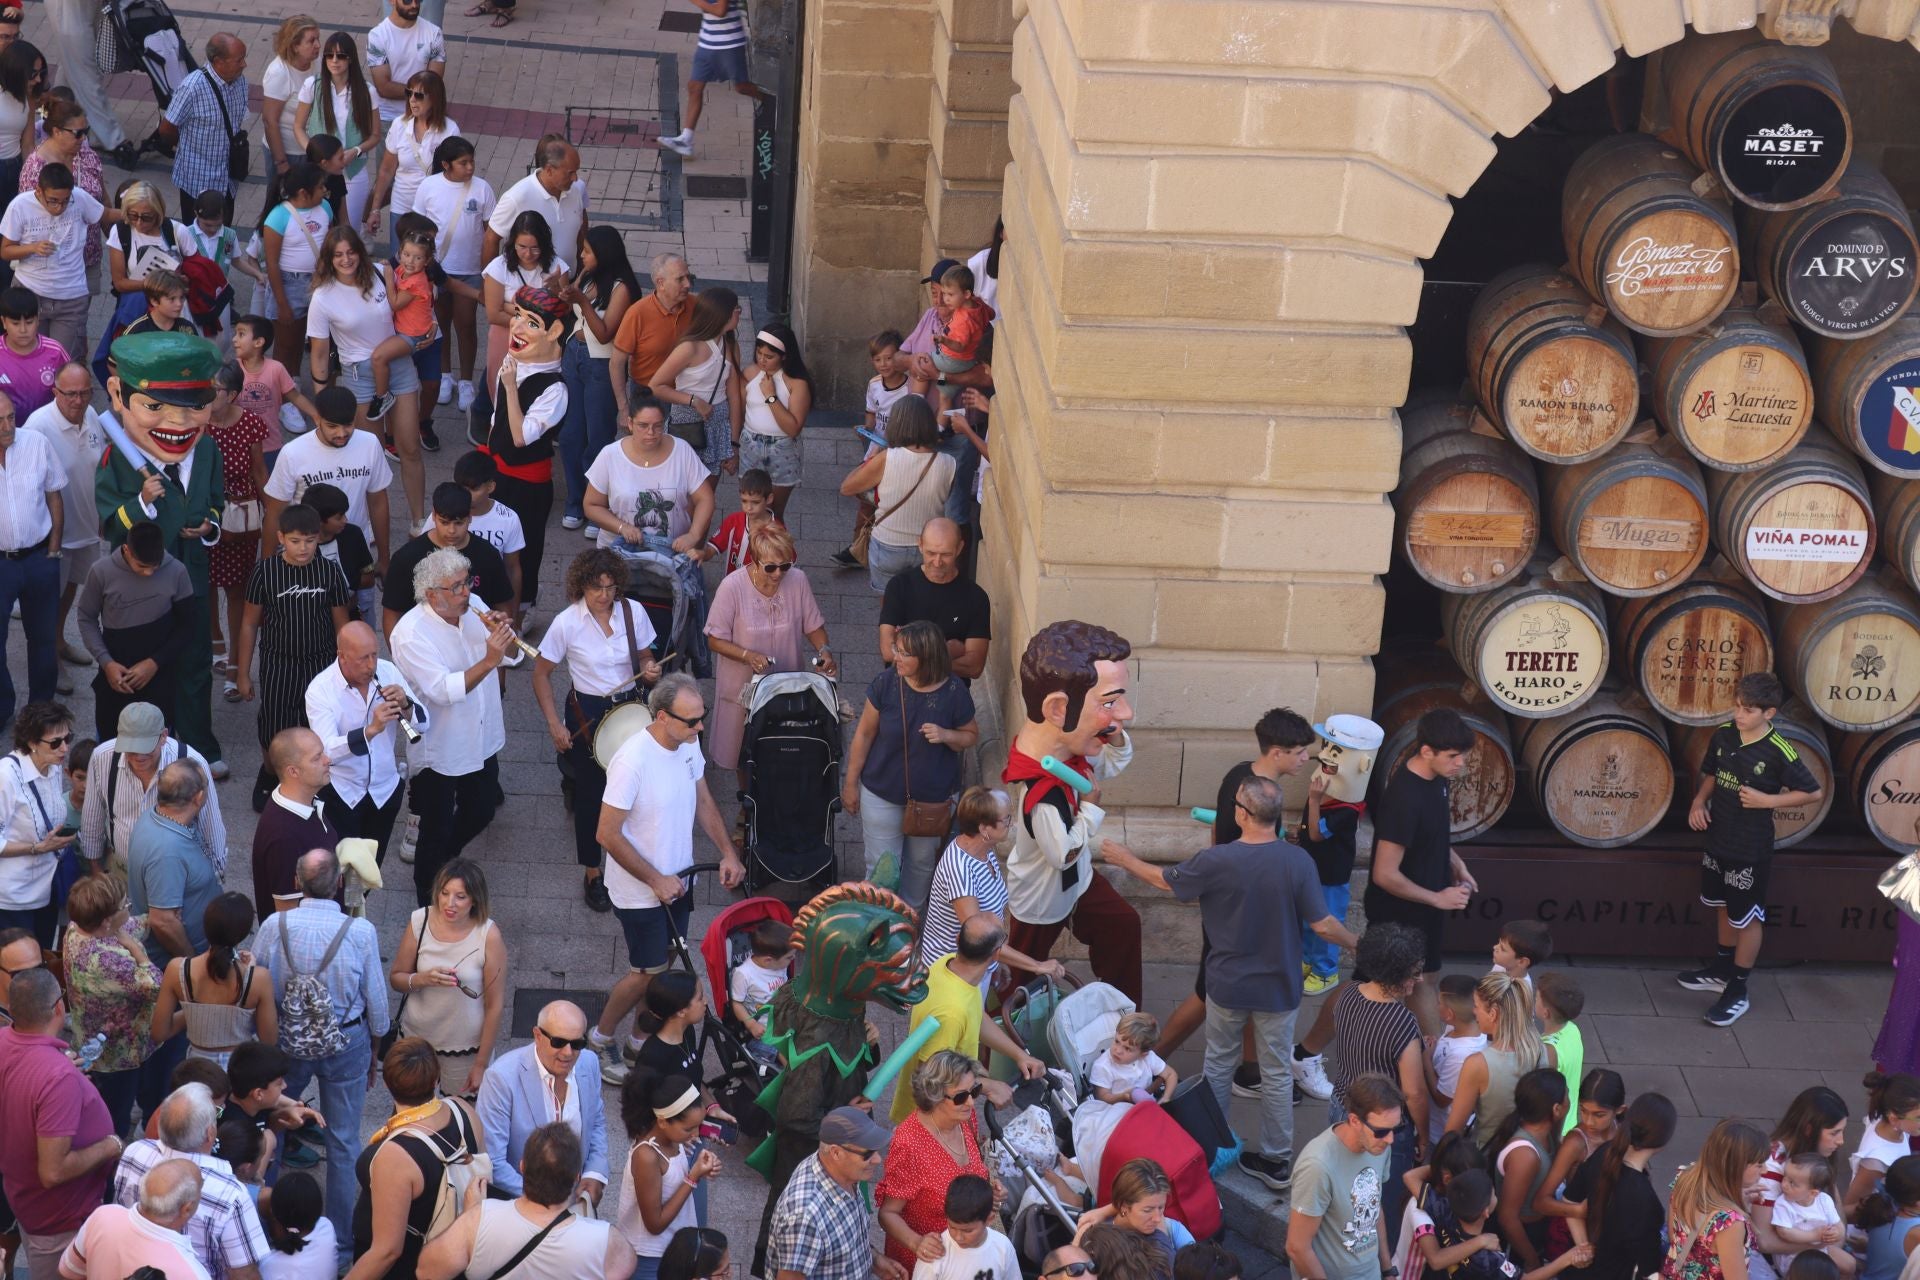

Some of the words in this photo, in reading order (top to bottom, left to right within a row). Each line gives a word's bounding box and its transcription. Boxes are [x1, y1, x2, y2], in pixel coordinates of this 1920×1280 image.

[1744, 139, 1824, 153] MASET
[1609, 236, 1695, 277] Gómez
[1827, 244, 1874, 254] DOMINIO
[1800, 299, 1825, 324] BODEGA
[1827, 320, 1858, 330] VIRGEN
[1860, 320, 1870, 328] DE
[1871, 316, 1880, 324] LA
[1879, 301, 1899, 318] VEGA
[1886, 371, 1920, 383] FUNDA
[1569, 401, 1616, 412] BILBAO
[1723, 391, 1799, 411] Martínez
[1726, 408, 1793, 426] Lacuesta
[302, 470, 334, 488] Palm
[336, 465, 370, 482] Angels
[1601, 520, 1680, 547] Muga
[1755, 529, 1794, 545] VIÑA
[1800, 533, 1860, 547] POMAL
[1853, 631, 1894, 640] BODEGAS
[1666, 637, 1746, 655] CARLOS
[1505, 651, 1579, 672] TERETE
[1662, 655, 1745, 672] SERRES
[1514, 676, 1566, 689] HARO
[1493, 680, 1583, 707] BODEGAS
[1827, 685, 1897, 702] RODA
[1573, 789, 1640, 799] MANZANOS
[1870, 779, 1920, 805] San
[1536, 898, 1702, 926] CAPITAL
[1766, 904, 1808, 929] EL
